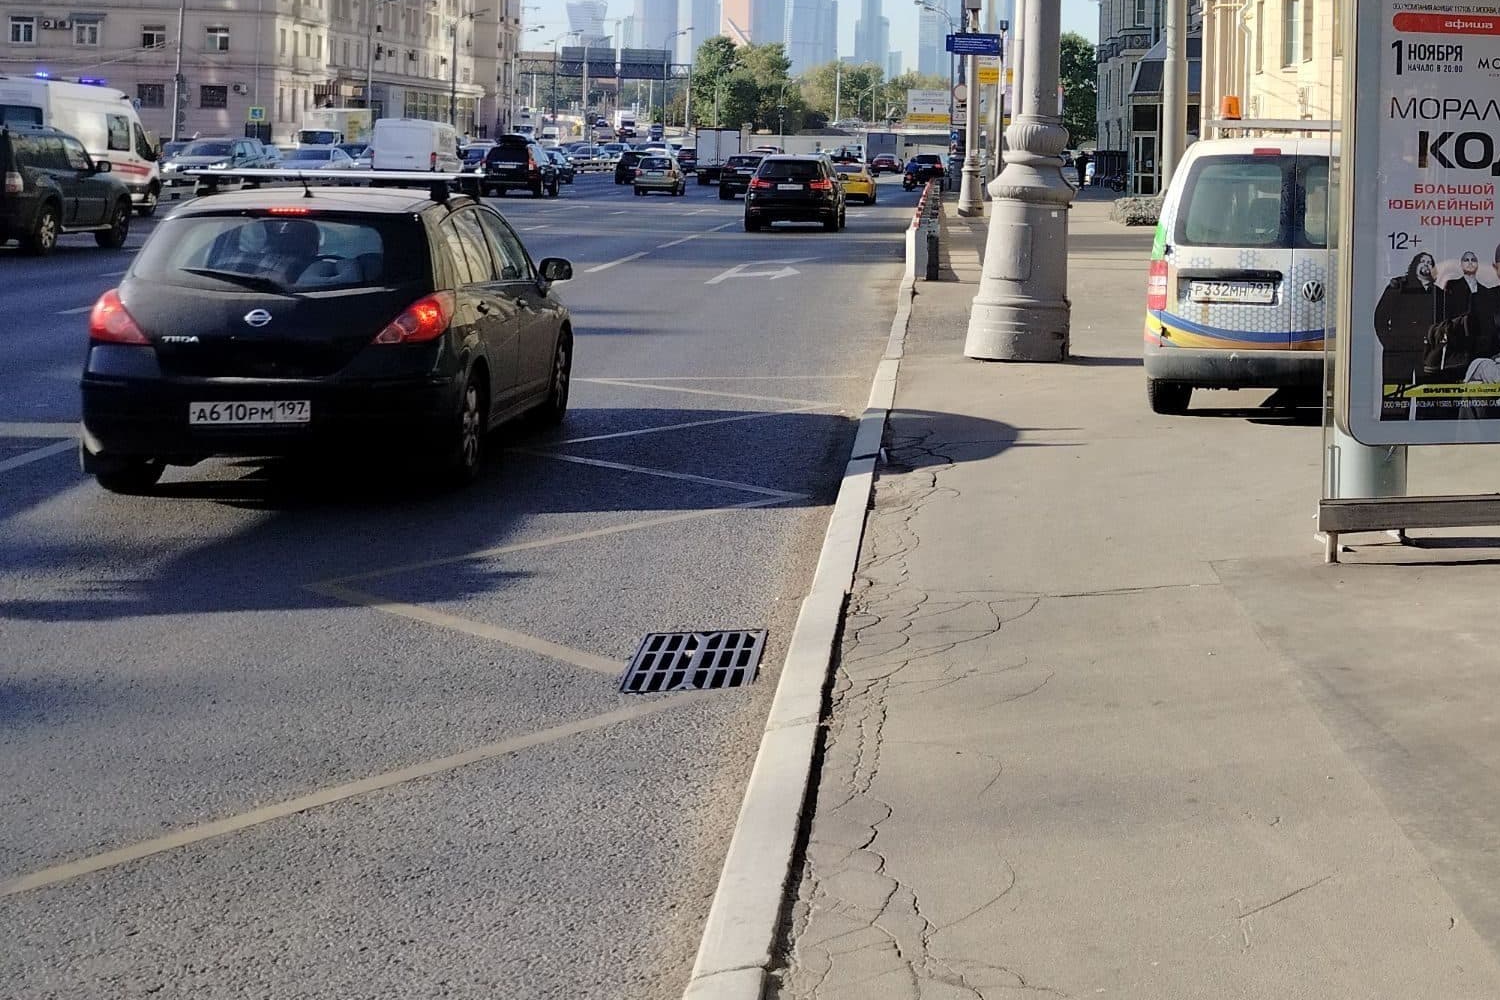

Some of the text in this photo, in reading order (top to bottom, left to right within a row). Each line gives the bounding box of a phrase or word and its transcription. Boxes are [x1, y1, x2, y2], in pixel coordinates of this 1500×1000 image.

[1444, 18, 1494, 30] афиша
[1391, 40, 1463, 76] 1 НОЯБРЯ
[1407, 63, 1463, 73] НАЧАЛО В 20:00
[1413, 182, 1495, 196] БОЛЬШОЙ
[1388, 198, 1495, 212] ЮБИЛЕЙНЫЙ
[1419, 215, 1496, 228] КОНЦЕРТ
[1387, 232, 1422, 250] 12+
[1249, 282, 1270, 294] 797
[197, 401, 306, 422] А610РМ 197
